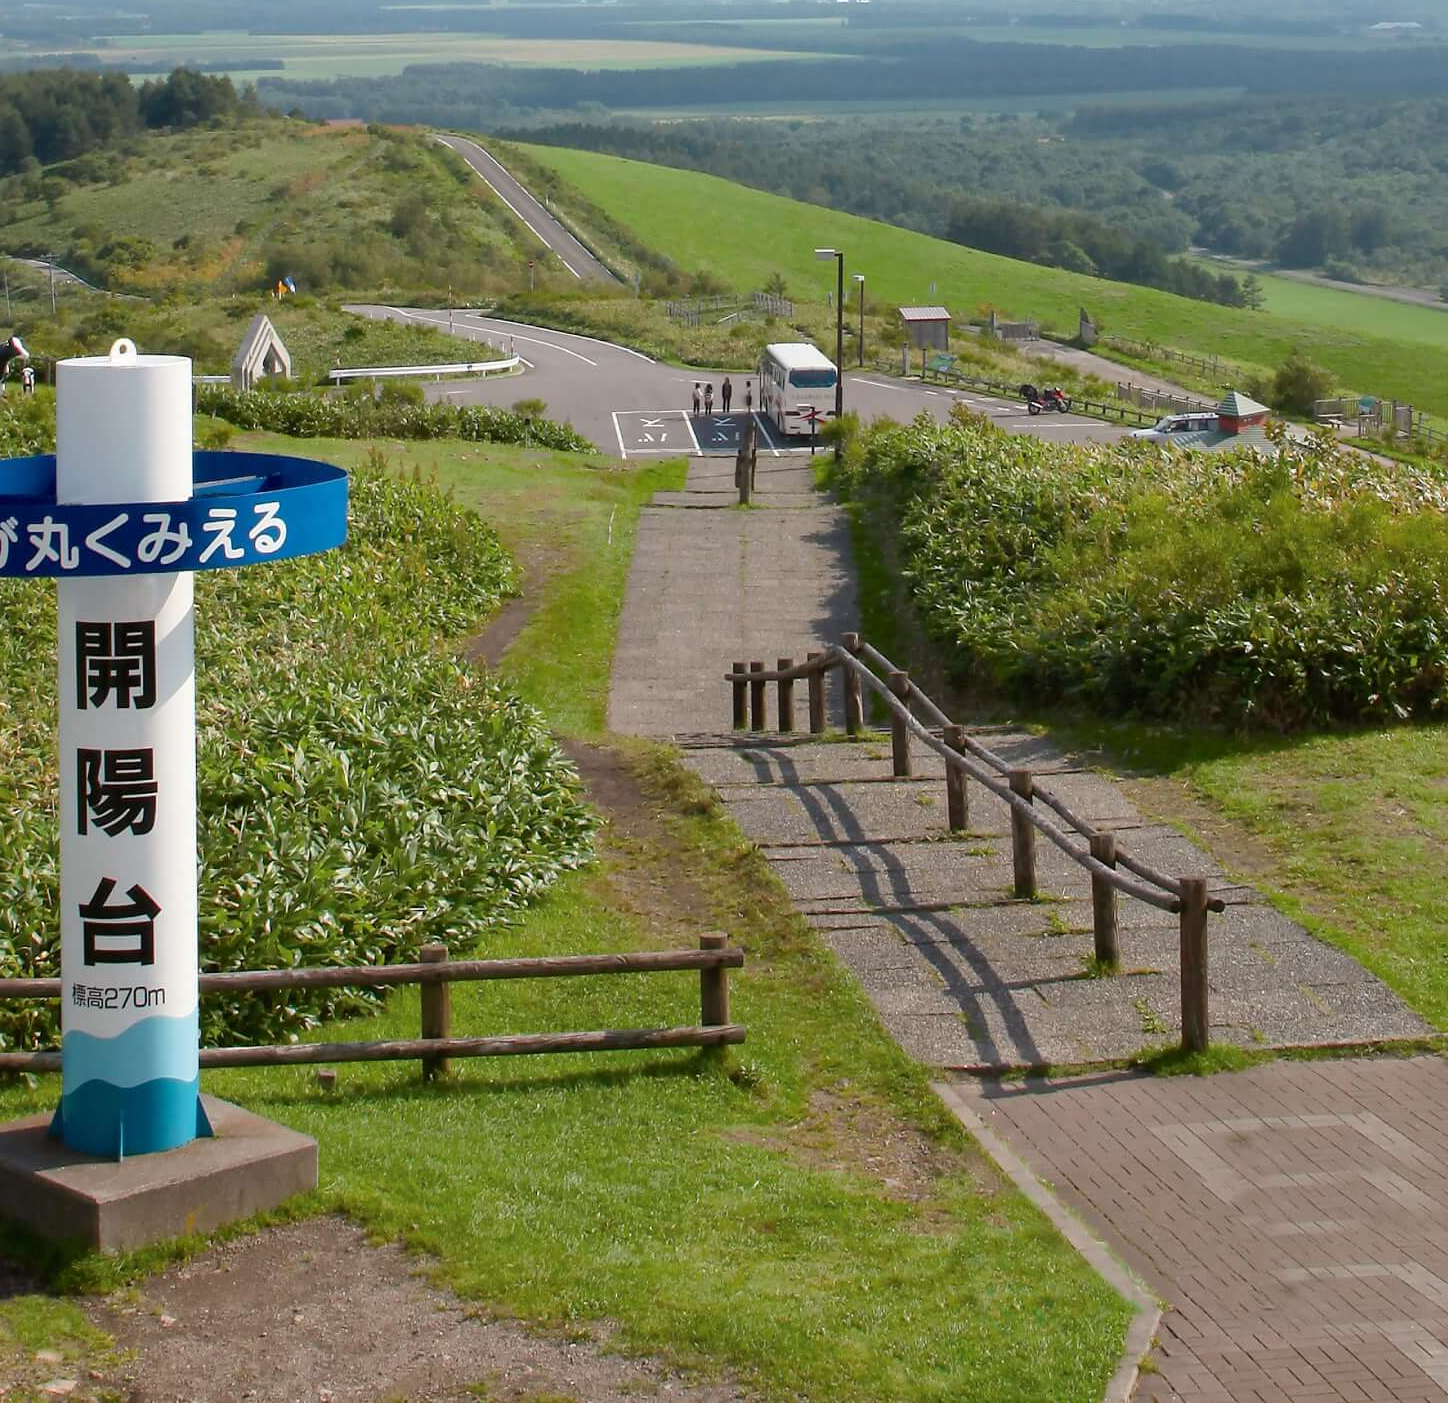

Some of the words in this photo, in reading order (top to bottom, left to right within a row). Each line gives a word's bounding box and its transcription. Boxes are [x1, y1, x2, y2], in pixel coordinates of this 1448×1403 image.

[75, 619, 162, 966] 開陽台
[72, 981, 166, 1009] 標高270m
